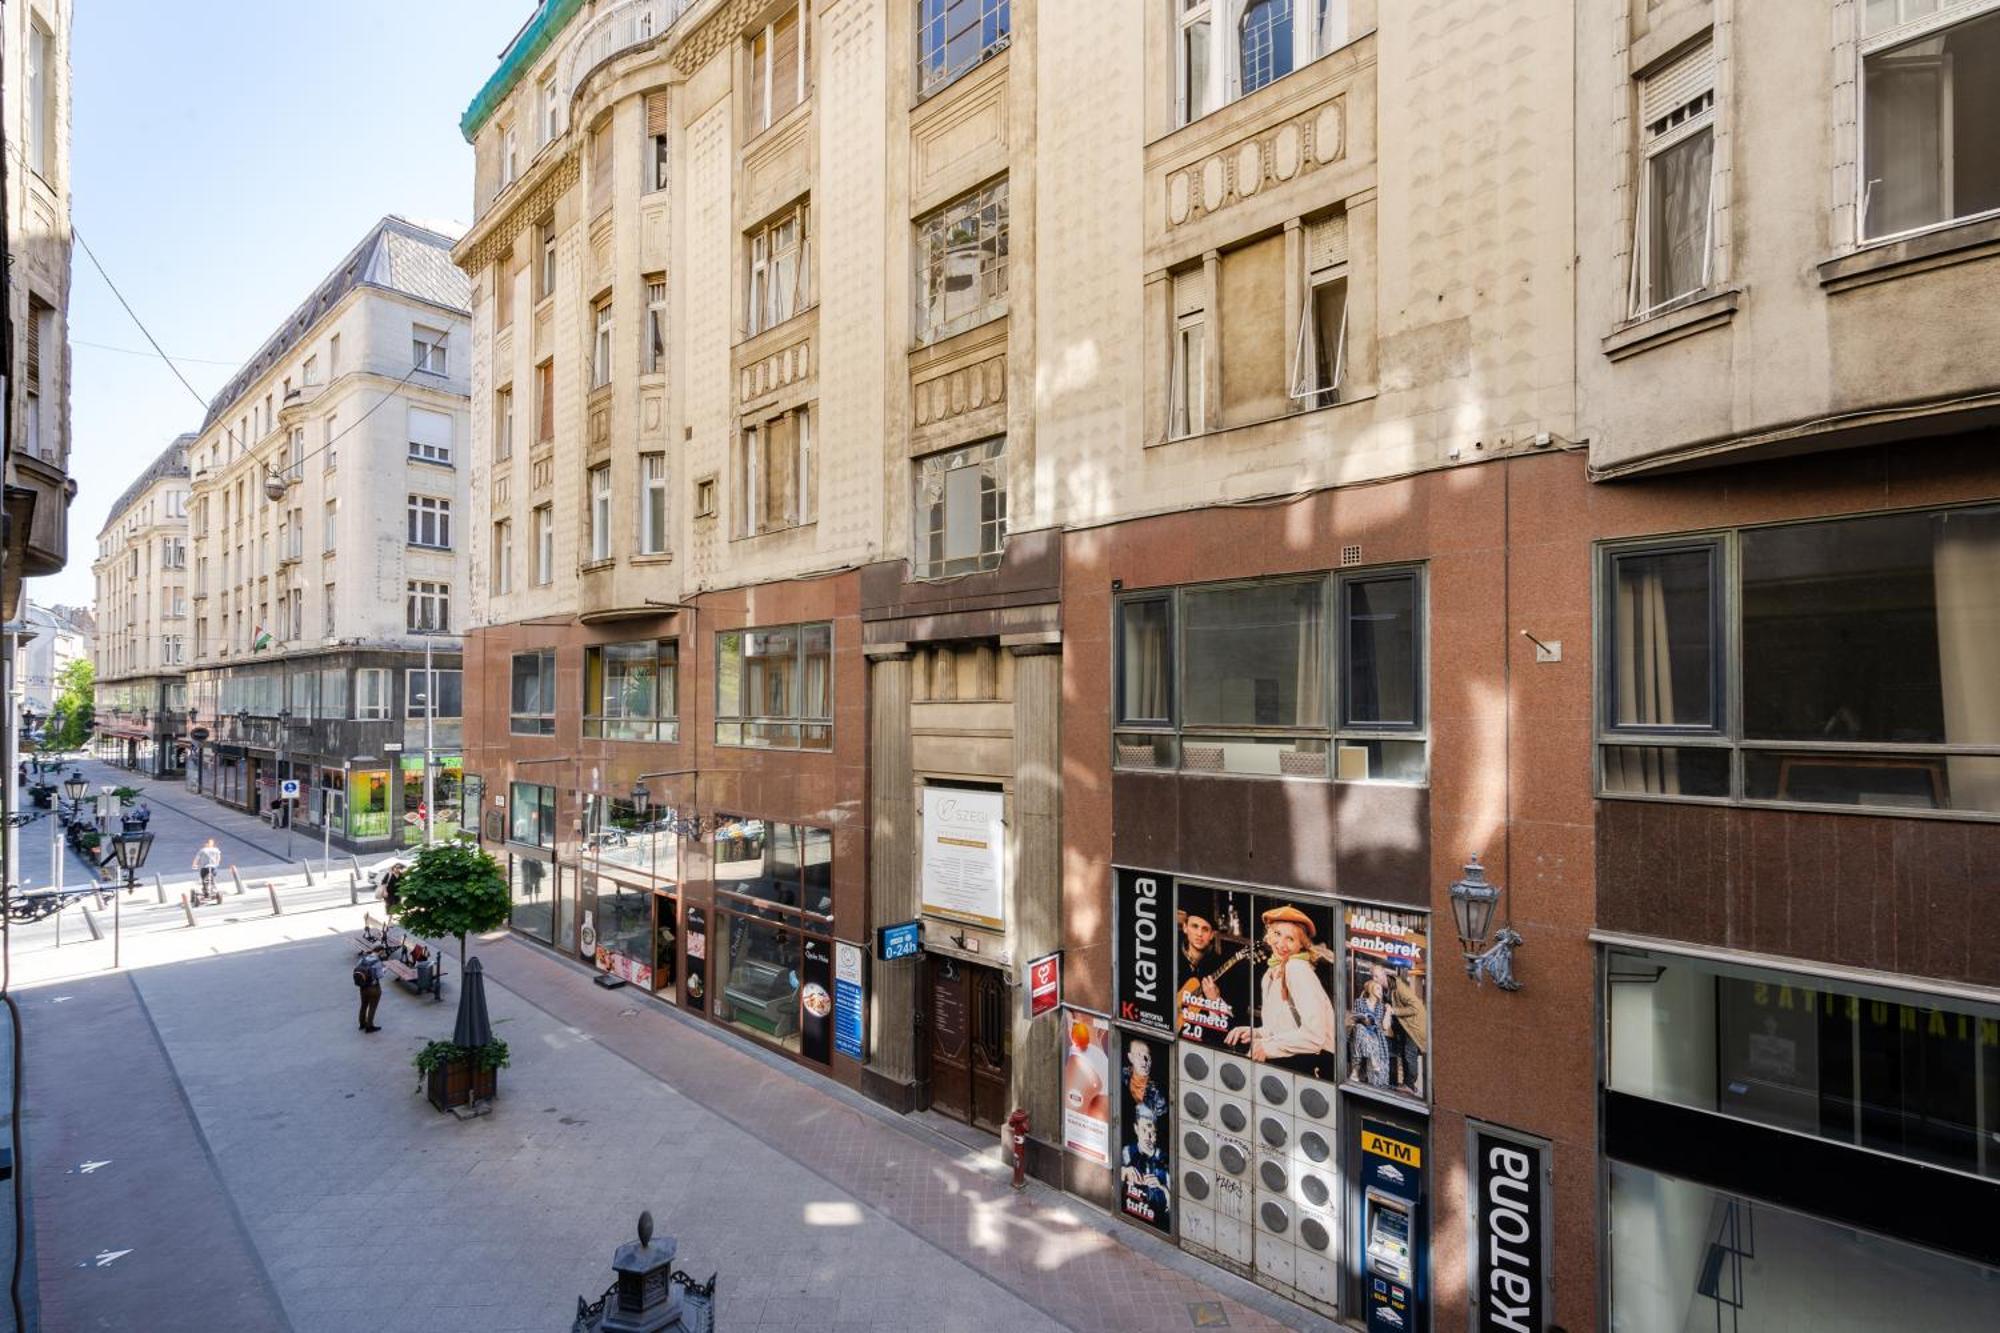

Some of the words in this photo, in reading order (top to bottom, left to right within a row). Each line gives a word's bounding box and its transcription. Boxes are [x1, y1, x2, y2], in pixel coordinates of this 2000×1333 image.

[1350, 914, 1414, 936] Mester-
[885, 941, 917, 959] 0-24h
[1350, 936, 1422, 959] emberek
[1182, 991, 1233, 1010] Rozsda-
[1182, 1023, 1203, 1038] 2.0
[1371, 1138, 1412, 1162] ATM
